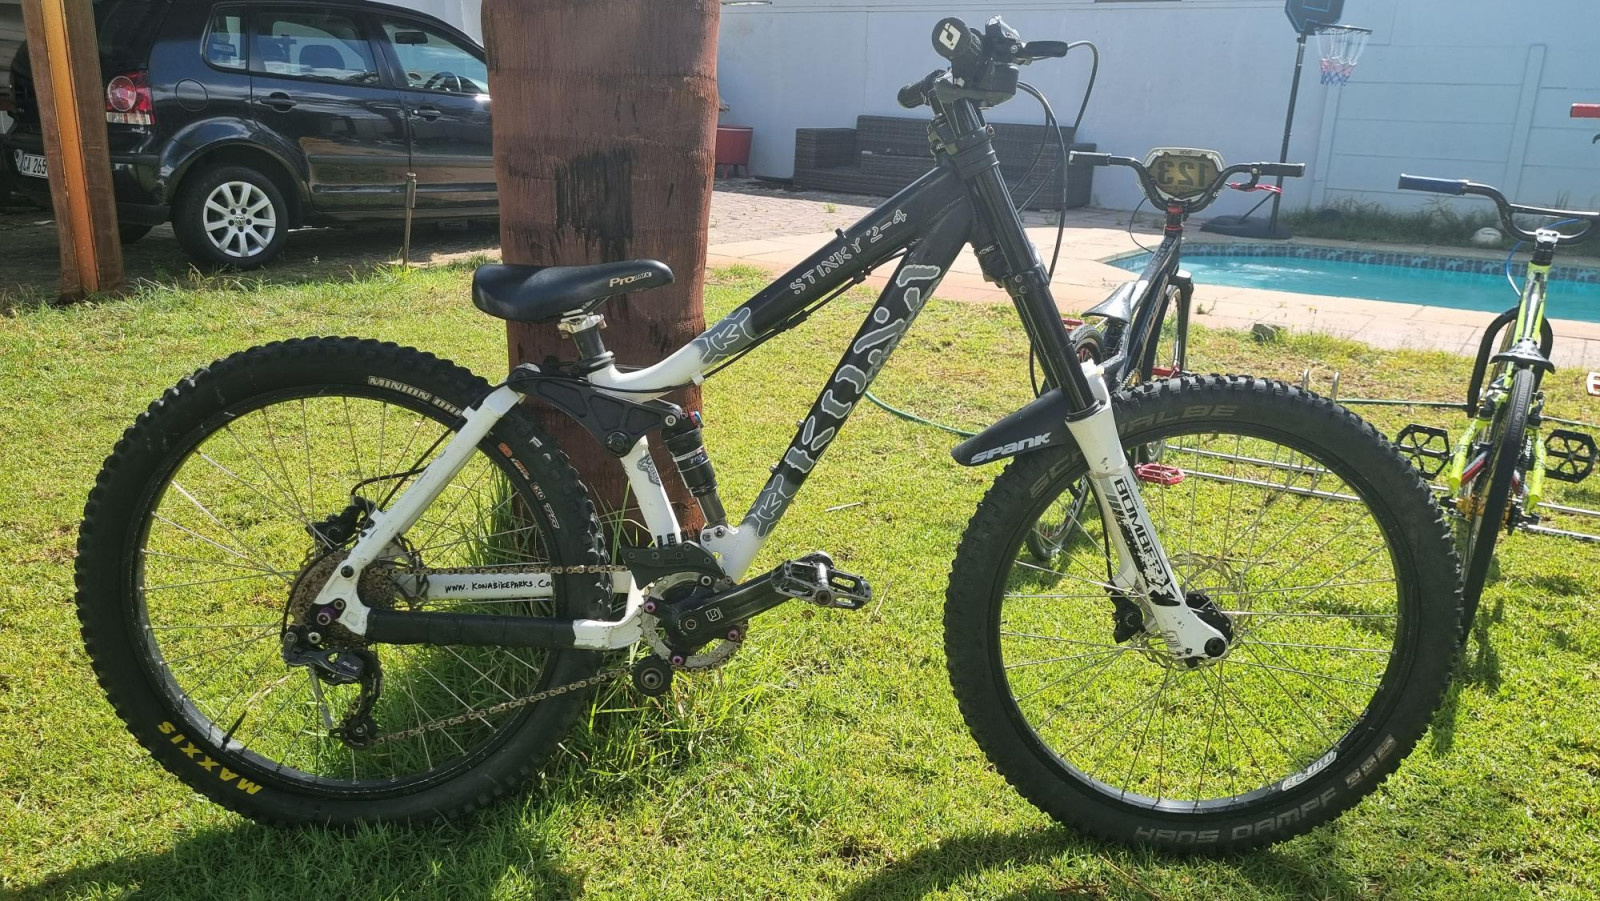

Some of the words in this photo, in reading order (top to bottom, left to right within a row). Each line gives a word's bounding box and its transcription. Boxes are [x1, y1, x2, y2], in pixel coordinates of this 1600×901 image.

[790, 237, 861, 294] STINKY
[865, 208, 907, 243] 2-4
[368, 375, 433, 402] MINION
[157, 721, 263, 795] MAXXIS
[1133, 825, 1220, 844] HANS
[1231, 786, 1337, 841] DAMPF
